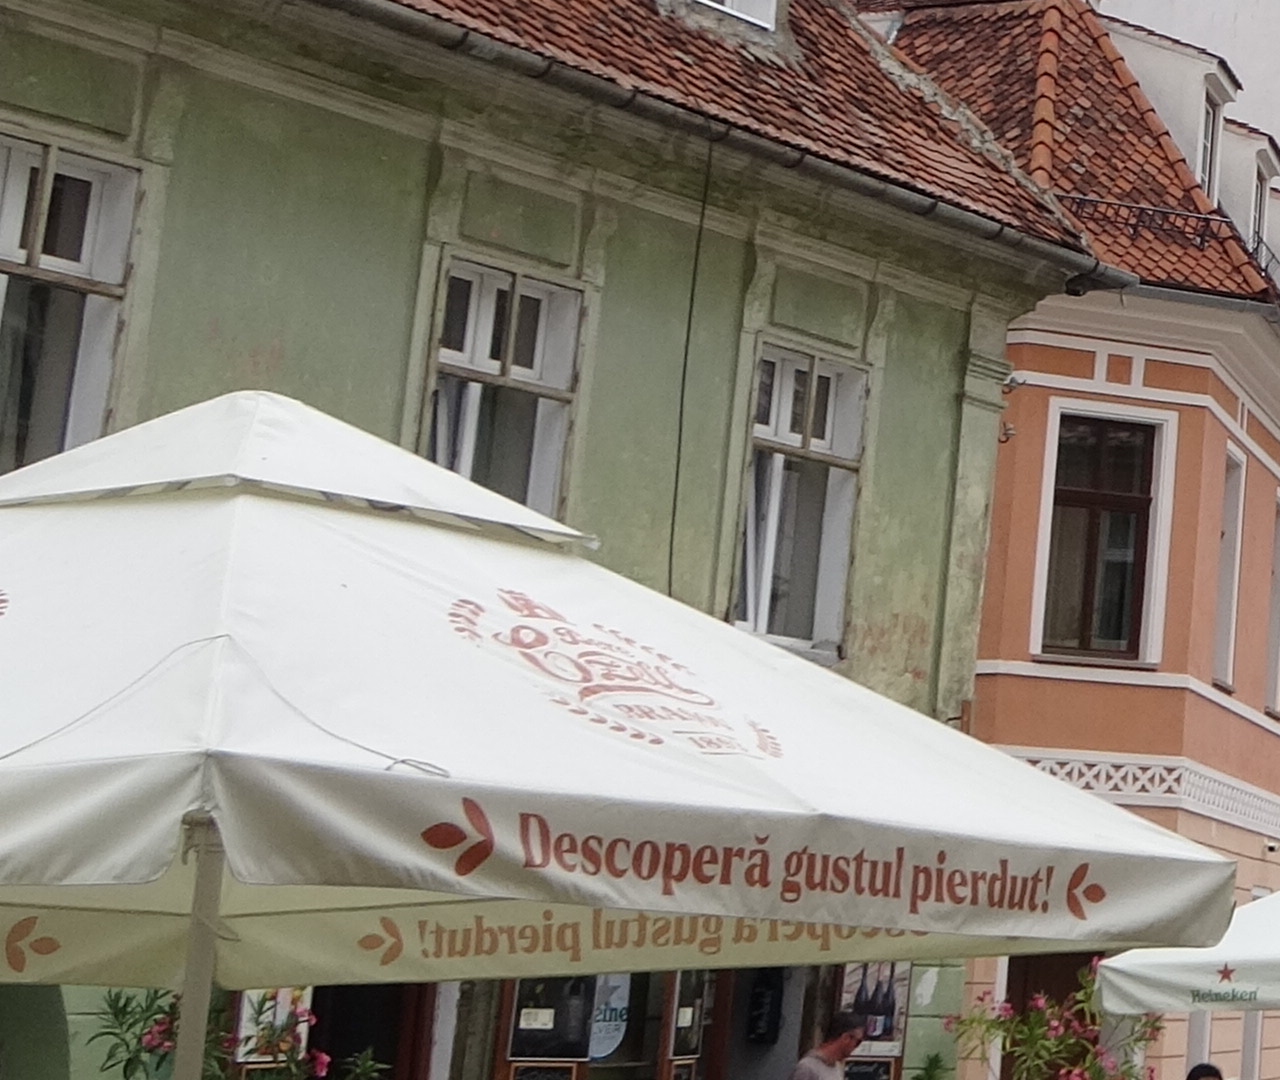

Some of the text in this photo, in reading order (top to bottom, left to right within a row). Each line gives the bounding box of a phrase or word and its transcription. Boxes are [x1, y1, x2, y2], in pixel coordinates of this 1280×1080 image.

[519, 812, 1055, 914] Descoperă gustul pierdut!
[1190, 987, 1259, 1003] Heineken
